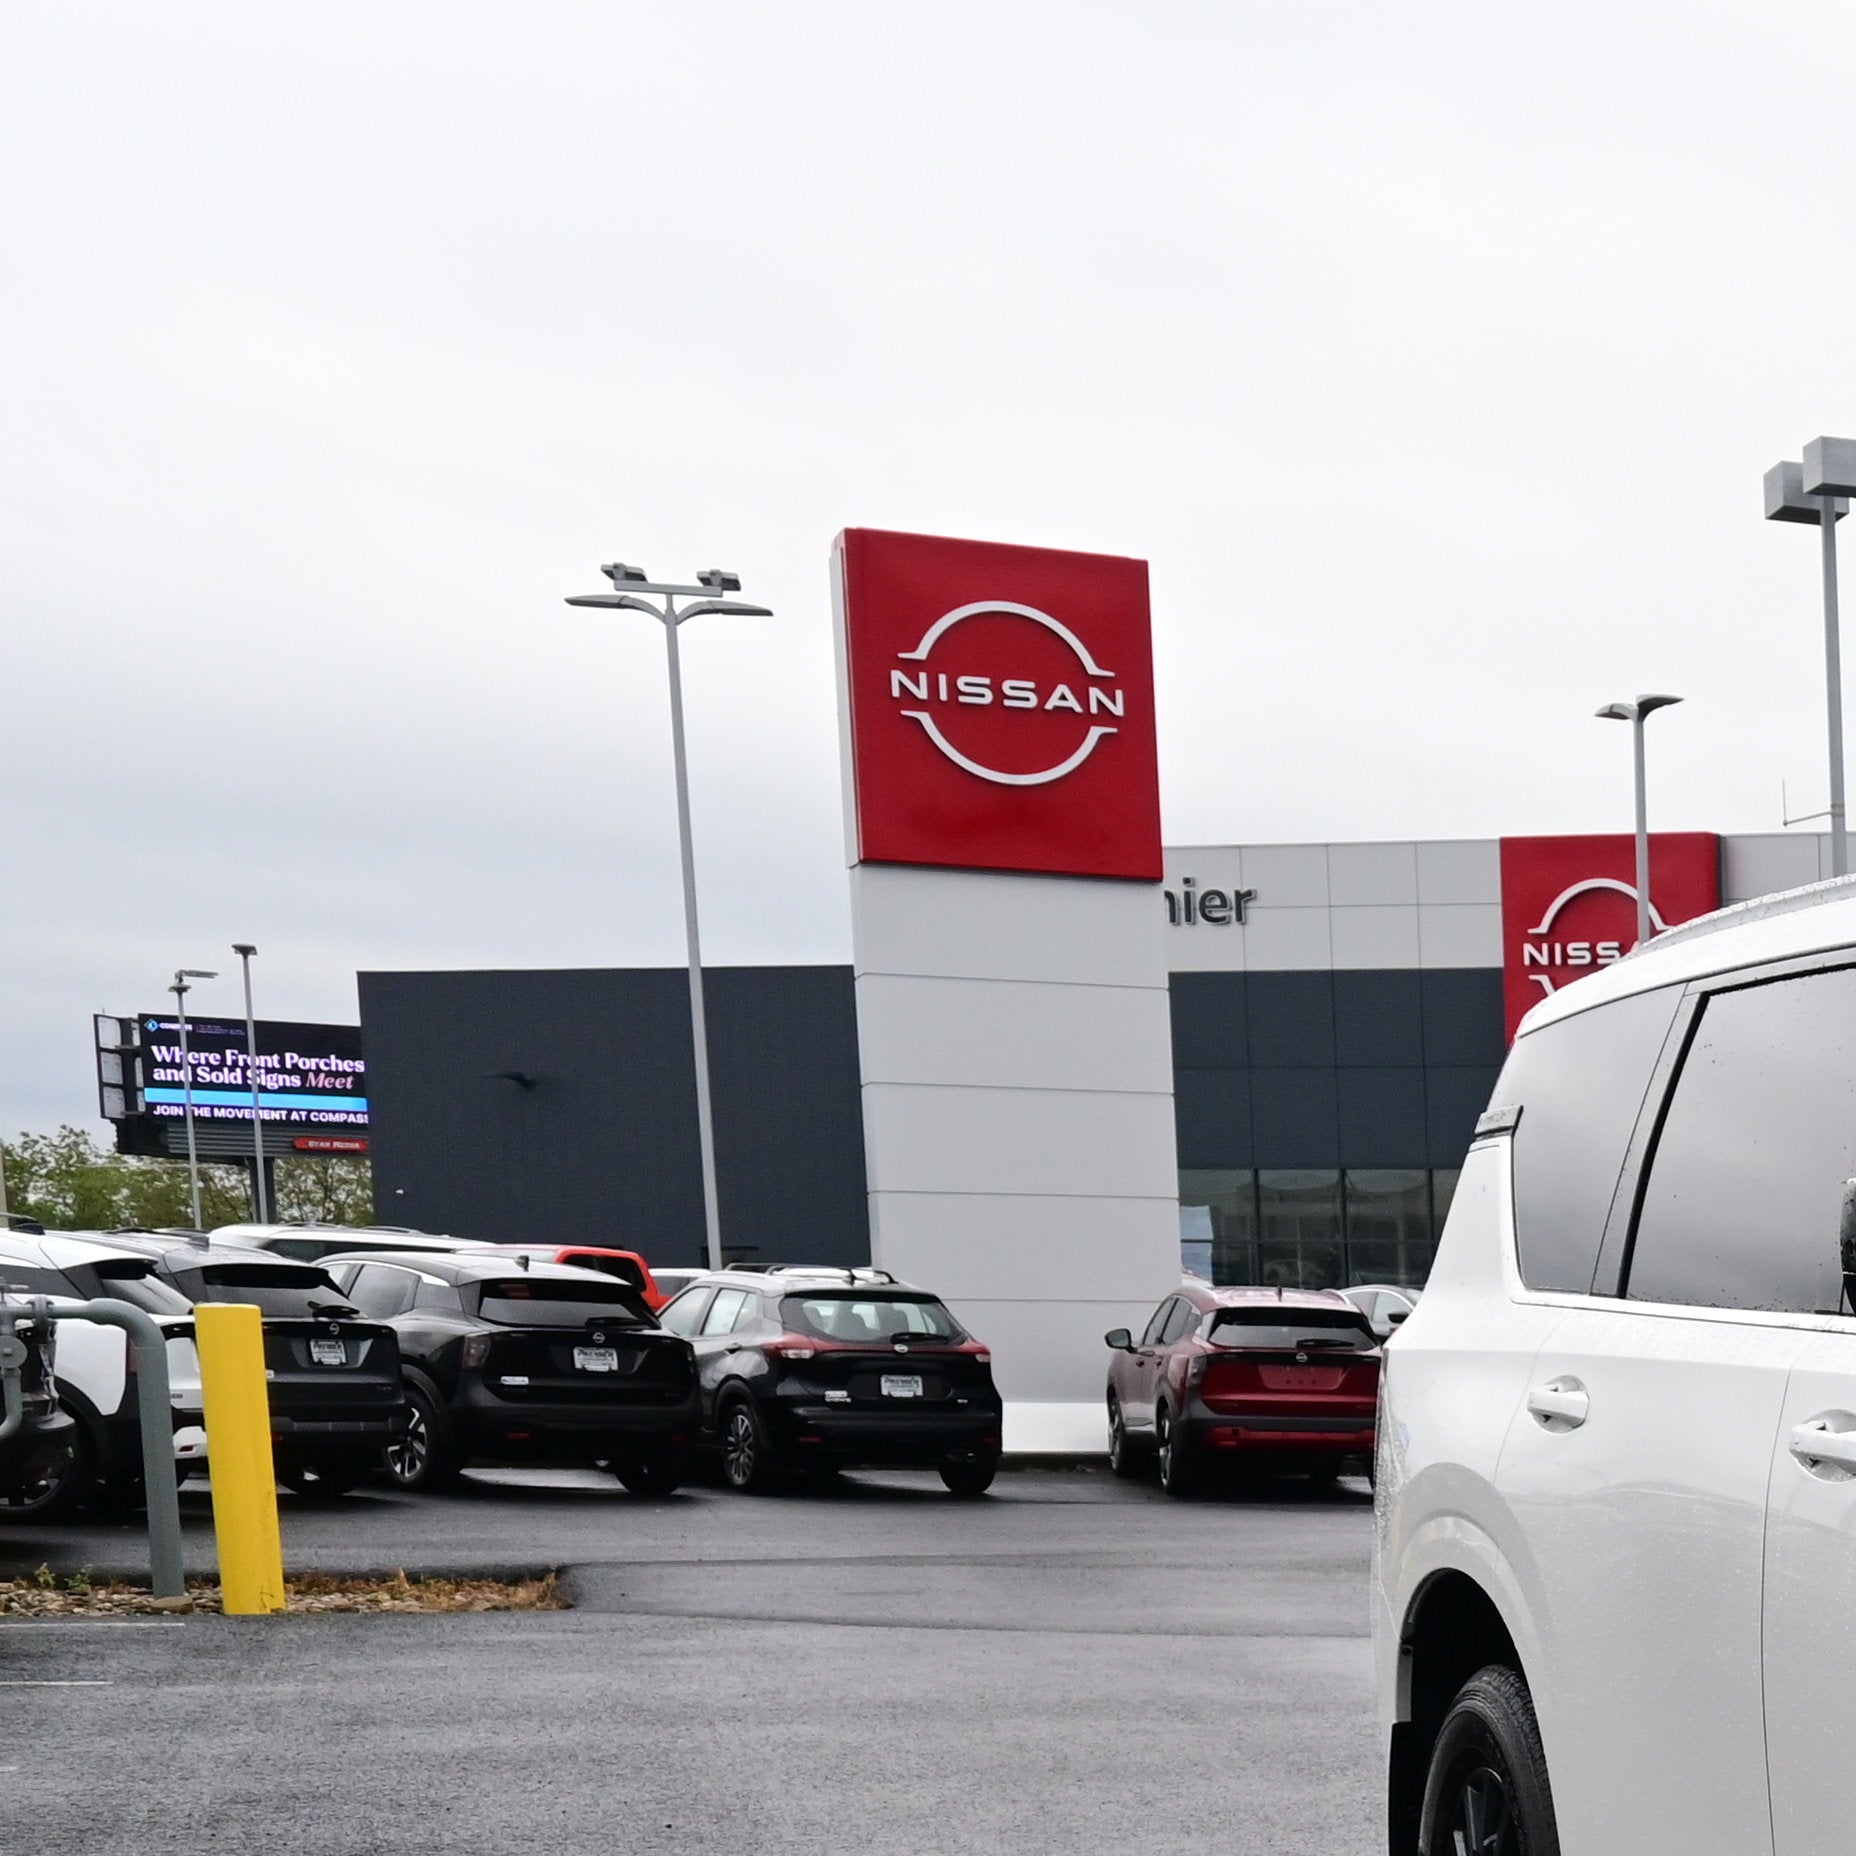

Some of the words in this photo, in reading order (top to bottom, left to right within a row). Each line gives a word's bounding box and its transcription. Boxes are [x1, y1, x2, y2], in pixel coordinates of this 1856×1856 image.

[890, 669, 1125, 717] NISSAN
[1523, 941, 1639, 967] NISS
[285, 1052, 365, 1073] Porches
[197, 1066, 242, 1085] Sold
[305, 1072, 354, 1090] Meet
[153, 1104, 184, 1117] JOIN
[290, 1110, 308, 1121] AT
